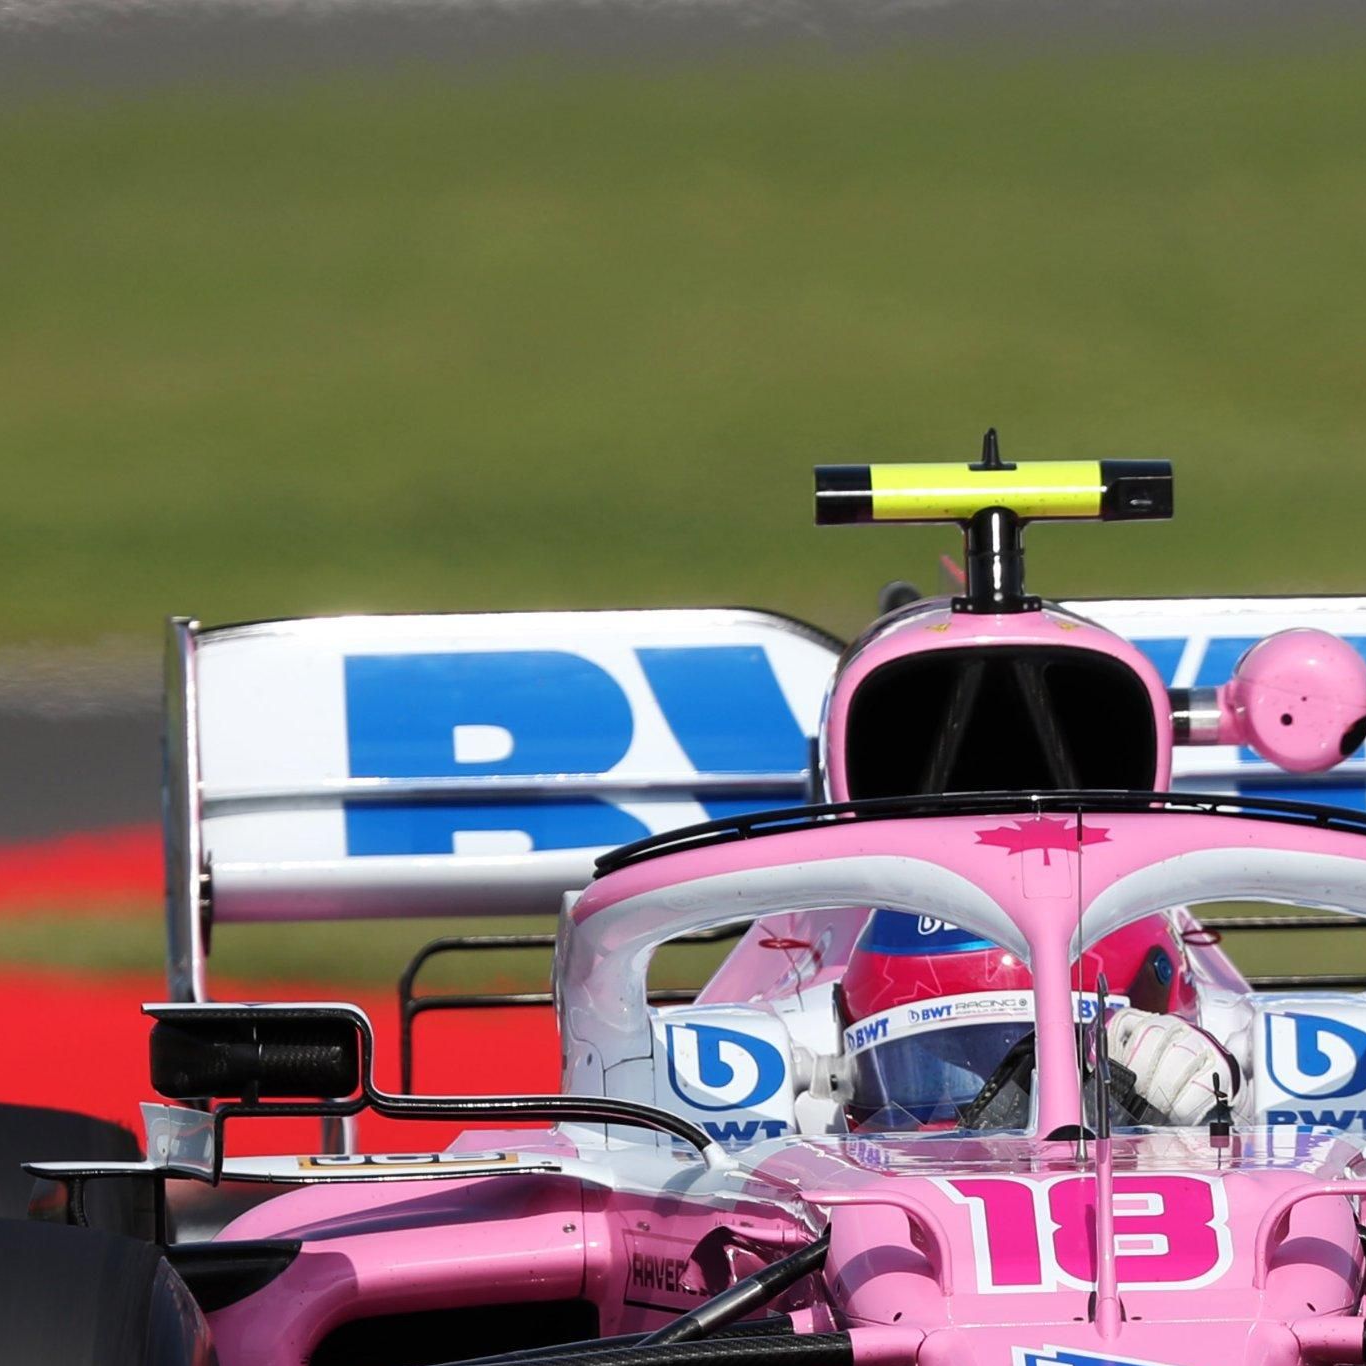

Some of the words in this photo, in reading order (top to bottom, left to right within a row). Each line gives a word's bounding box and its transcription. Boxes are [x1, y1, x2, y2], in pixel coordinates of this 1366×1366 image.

[922, 1005, 952, 1020] BWT
[855, 1018, 889, 1049] BWT
[671, 1121, 787, 1142] WT
[926, 1173, 1233, 1293] 18
